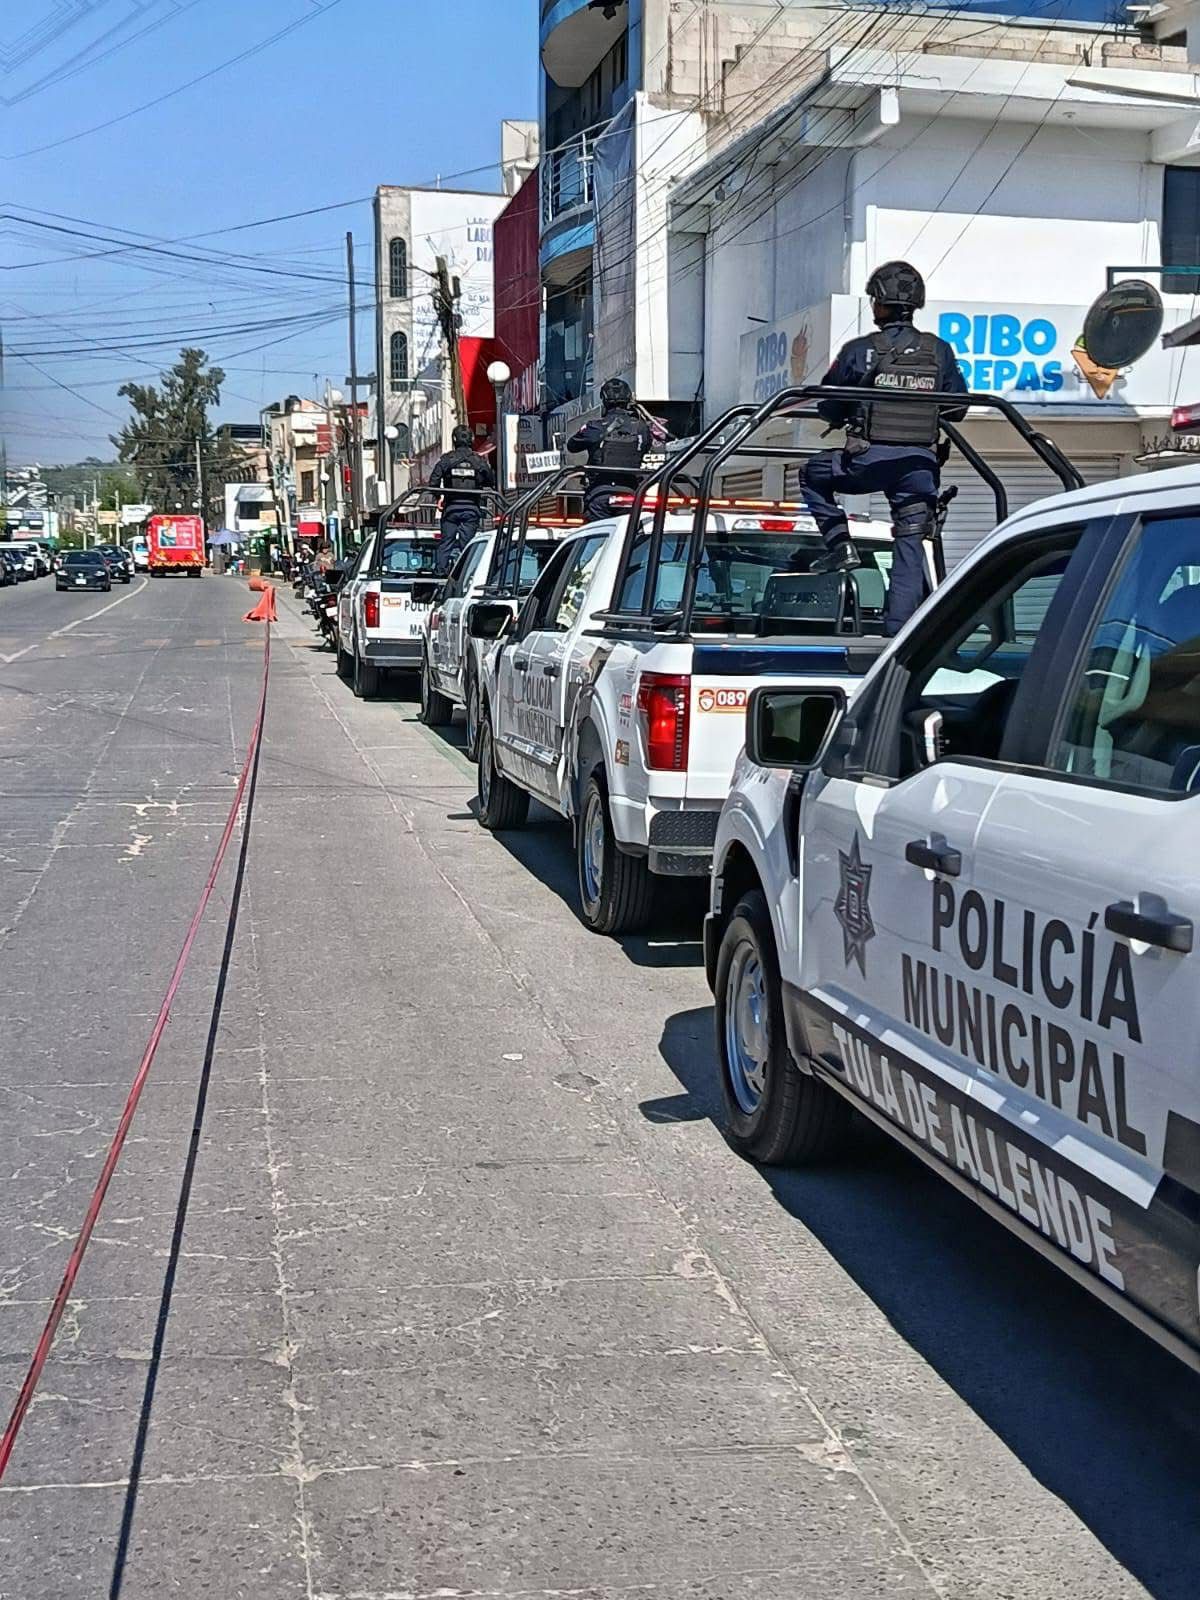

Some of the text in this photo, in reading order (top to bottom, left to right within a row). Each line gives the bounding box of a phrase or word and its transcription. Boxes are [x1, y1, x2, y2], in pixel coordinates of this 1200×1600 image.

[757, 331, 787, 377] RIBO
[938, 312, 1057, 357] RIBO
[956, 359, 1064, 392] REPAS
[717, 691, 746, 706] 089
[932, 877, 1143, 1044] POLICÍA
[902, 953, 1148, 1157] MUNICIPAL
[832, 1022, 1127, 1292] TULA DE ALLENDE
